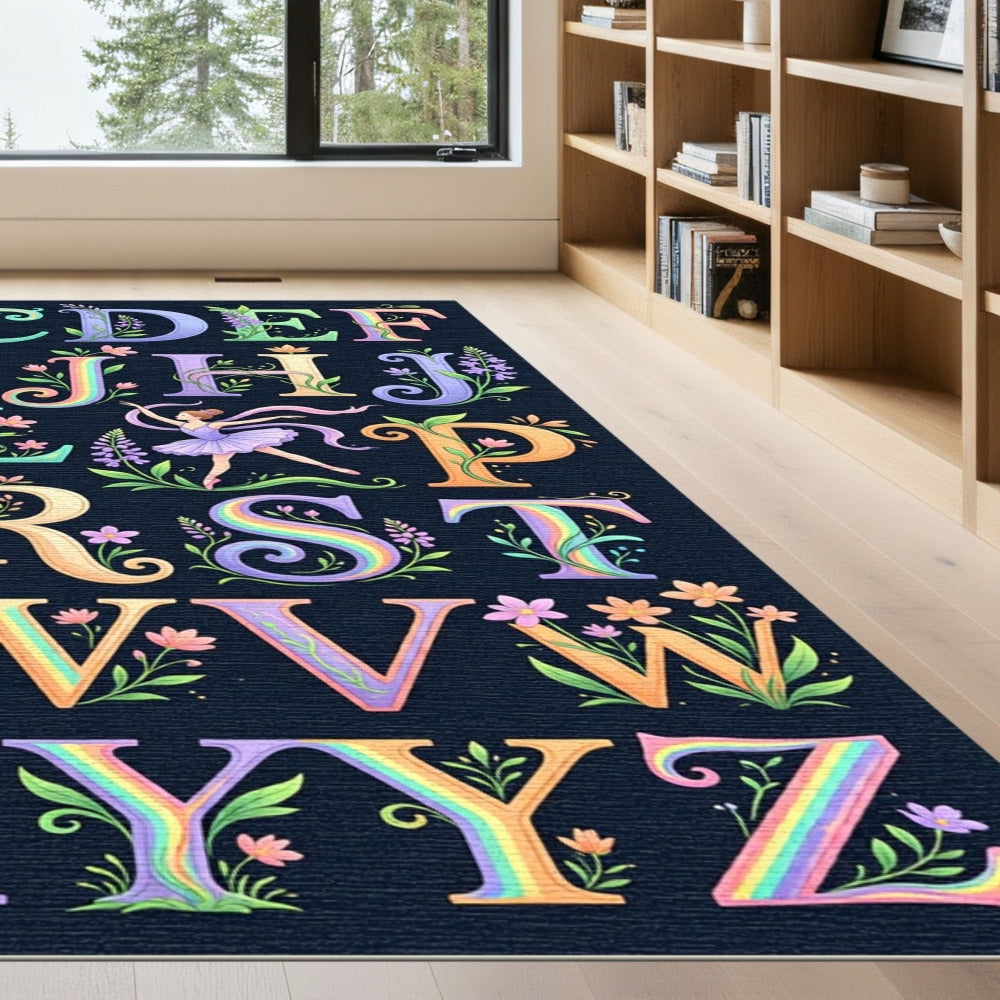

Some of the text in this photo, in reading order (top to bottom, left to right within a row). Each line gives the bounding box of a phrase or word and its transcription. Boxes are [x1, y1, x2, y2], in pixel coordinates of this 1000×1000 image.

[64, 308, 208, 342] D
[222, 308, 338, 342] E
[329, 308, 447, 342] F
[2, 356, 116, 408] J
[152, 354, 357, 397] H
[372, 352, 474, 405] J
[361, 422, 576, 487] P
[209, 494, 403, 583] S
[437, 498, 657, 580] T
[190, 598, 476, 712] V
[510, 618, 790, 709] W
[1, 738, 295, 908] Y
[295, 738, 626, 905] Y
[636, 731, 1000, 907] Z
